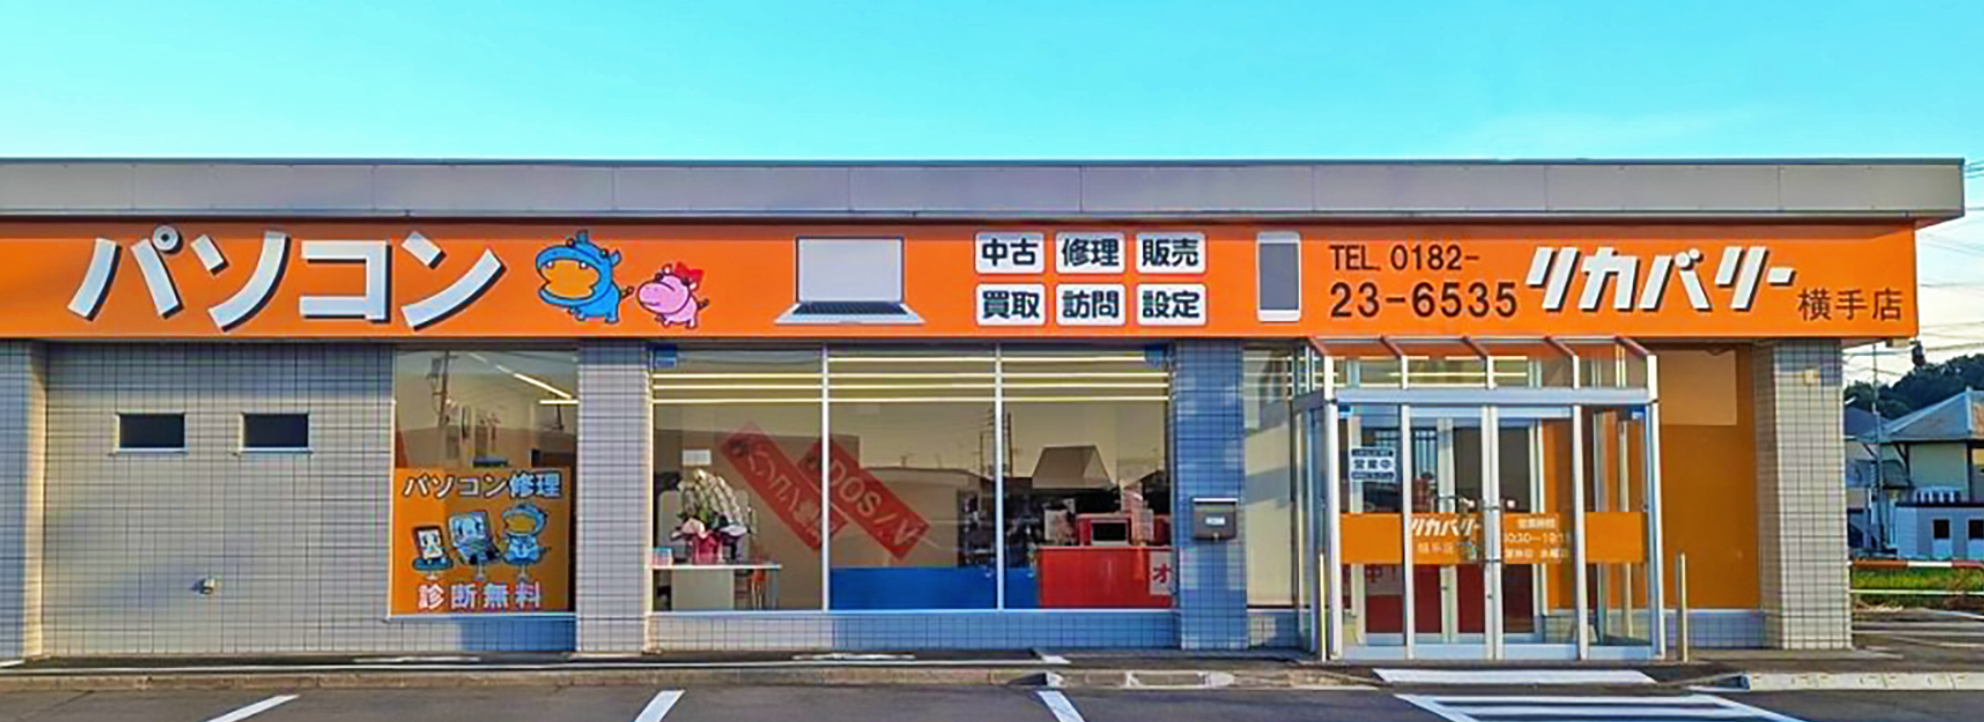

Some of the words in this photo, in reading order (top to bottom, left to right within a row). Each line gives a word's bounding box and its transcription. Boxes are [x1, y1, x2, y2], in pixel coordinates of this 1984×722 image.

[981, 237, 1037, 268] 中古
[1061, 237, 1121, 268] 修理
[1141, 237, 1200, 268] 販売
[1390, 245, 1479, 271] 0182-
[67, 225, 505, 329] パソコン
[1525, 246, 1796, 312] リカバリー
[981, 289, 1038, 320] 買取
[1061, 289, 1120, 320] 訪問
[1141, 289, 1200, 320] 設定
[1330, 281, 1518, 319] 23-6535
[1797, 288, 1903, 322] 横手店
[403, 469, 562, 499] パソコン修理
[418, 582, 542, 610] 診断無料
